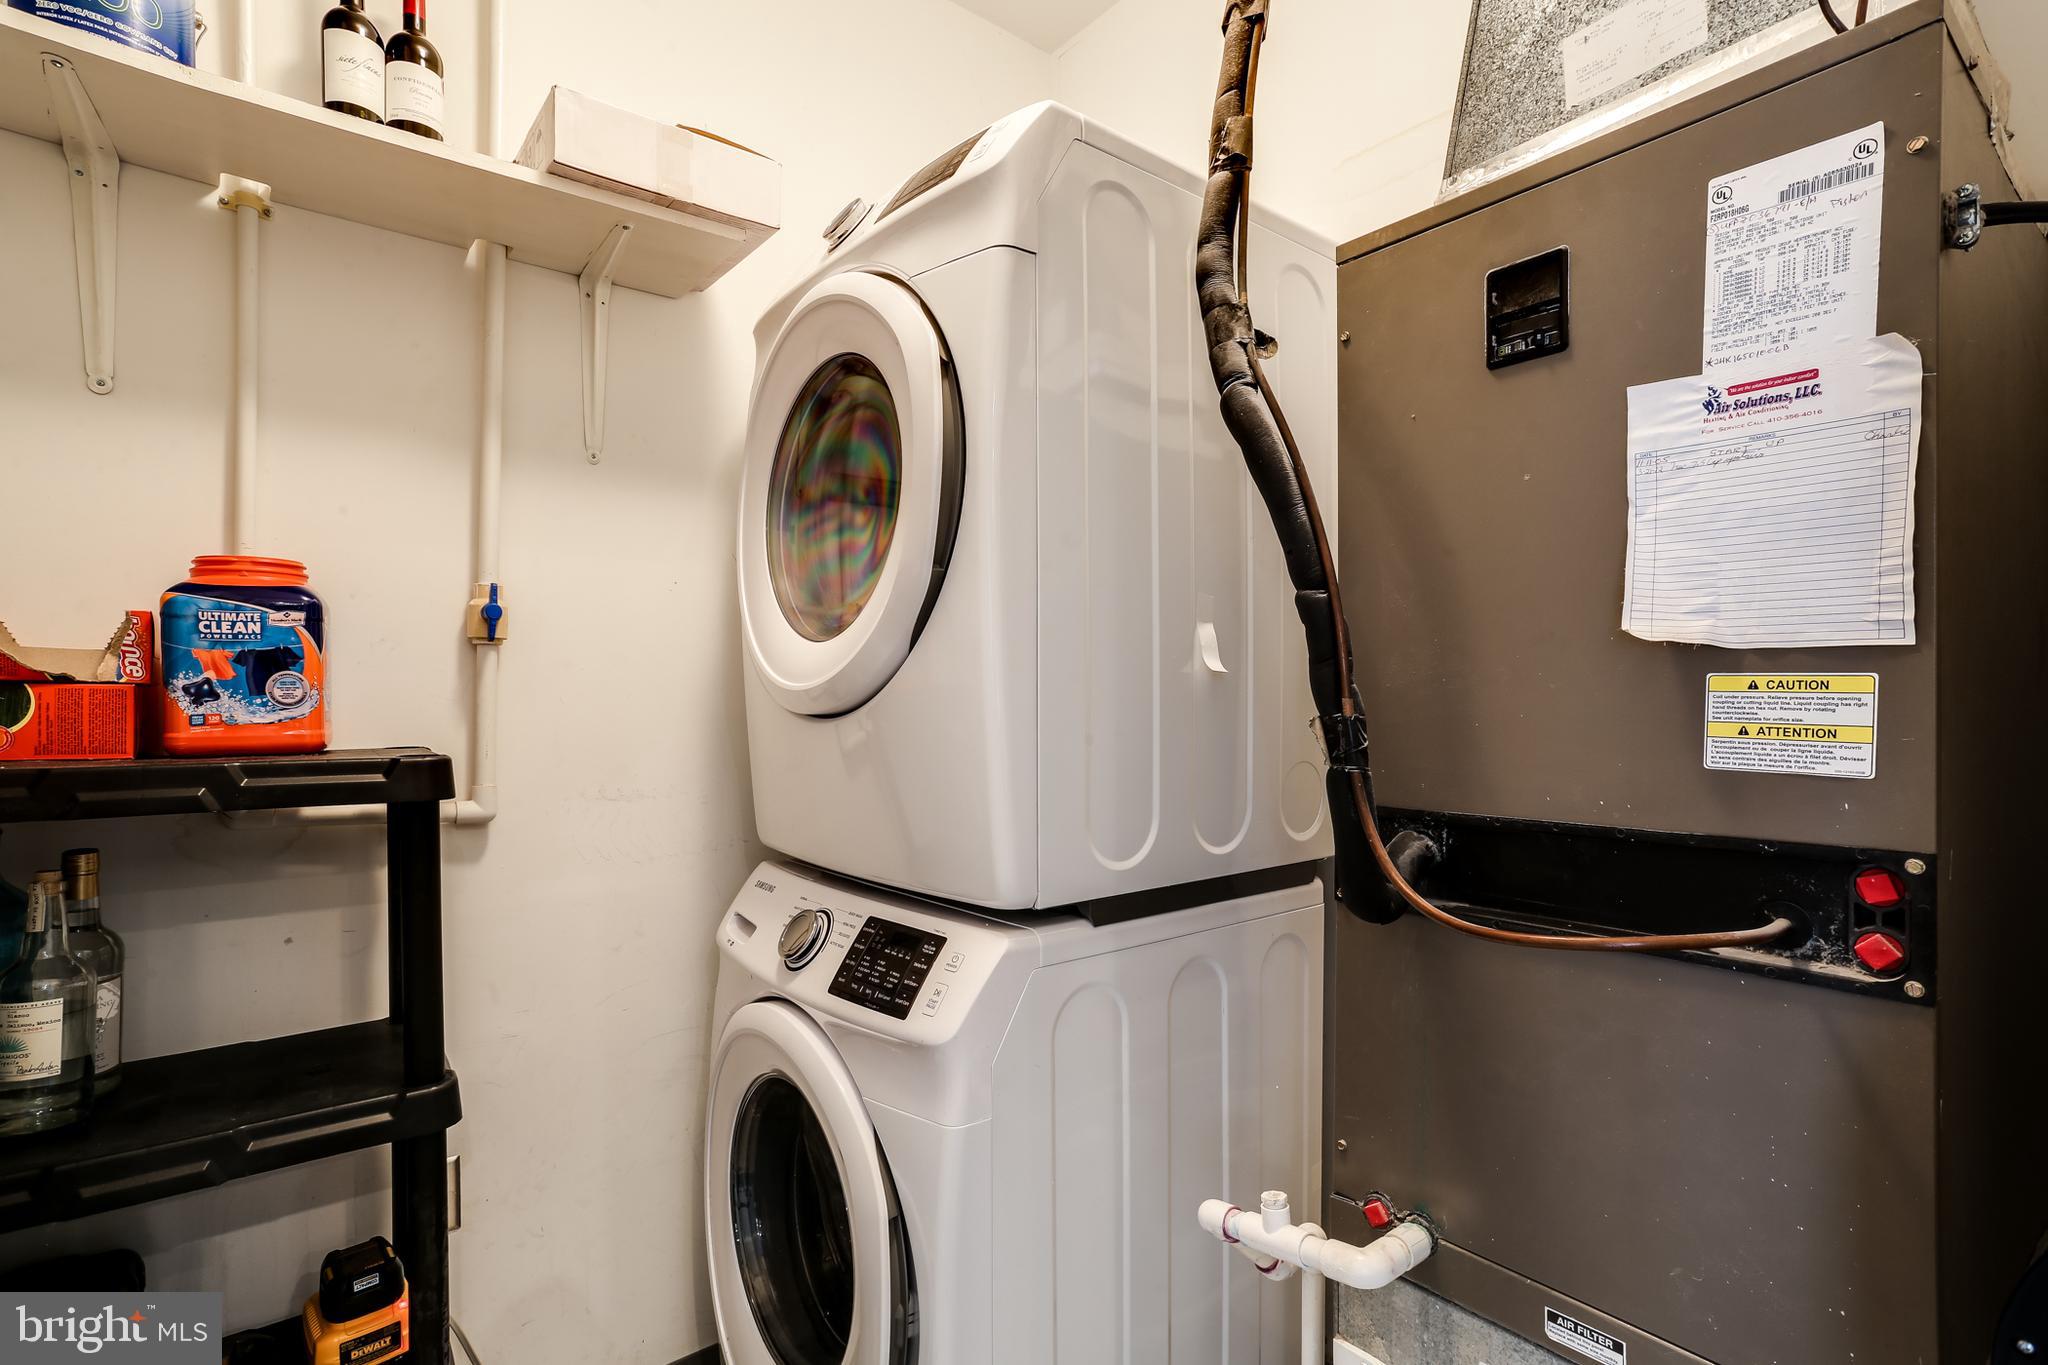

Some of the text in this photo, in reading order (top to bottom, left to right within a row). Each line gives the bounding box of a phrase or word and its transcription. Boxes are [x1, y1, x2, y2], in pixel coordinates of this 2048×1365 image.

[1788, 178, 1810, 188] SERIAL
[1710, 204, 1728, 214] MODEL
[1713, 383, 1823, 415] Air Solutions, LLC.
[198, 611, 261, 622] ULTIMATE
[198, 621, 262, 634] CLEAN
[1766, 680, 1830, 690] CAUTION
[1756, 727, 1837, 738] ATTENTION
[754, 879, 777, 893] SAMSUNG
[1557, 1316, 1614, 1350] AIR FILTER
